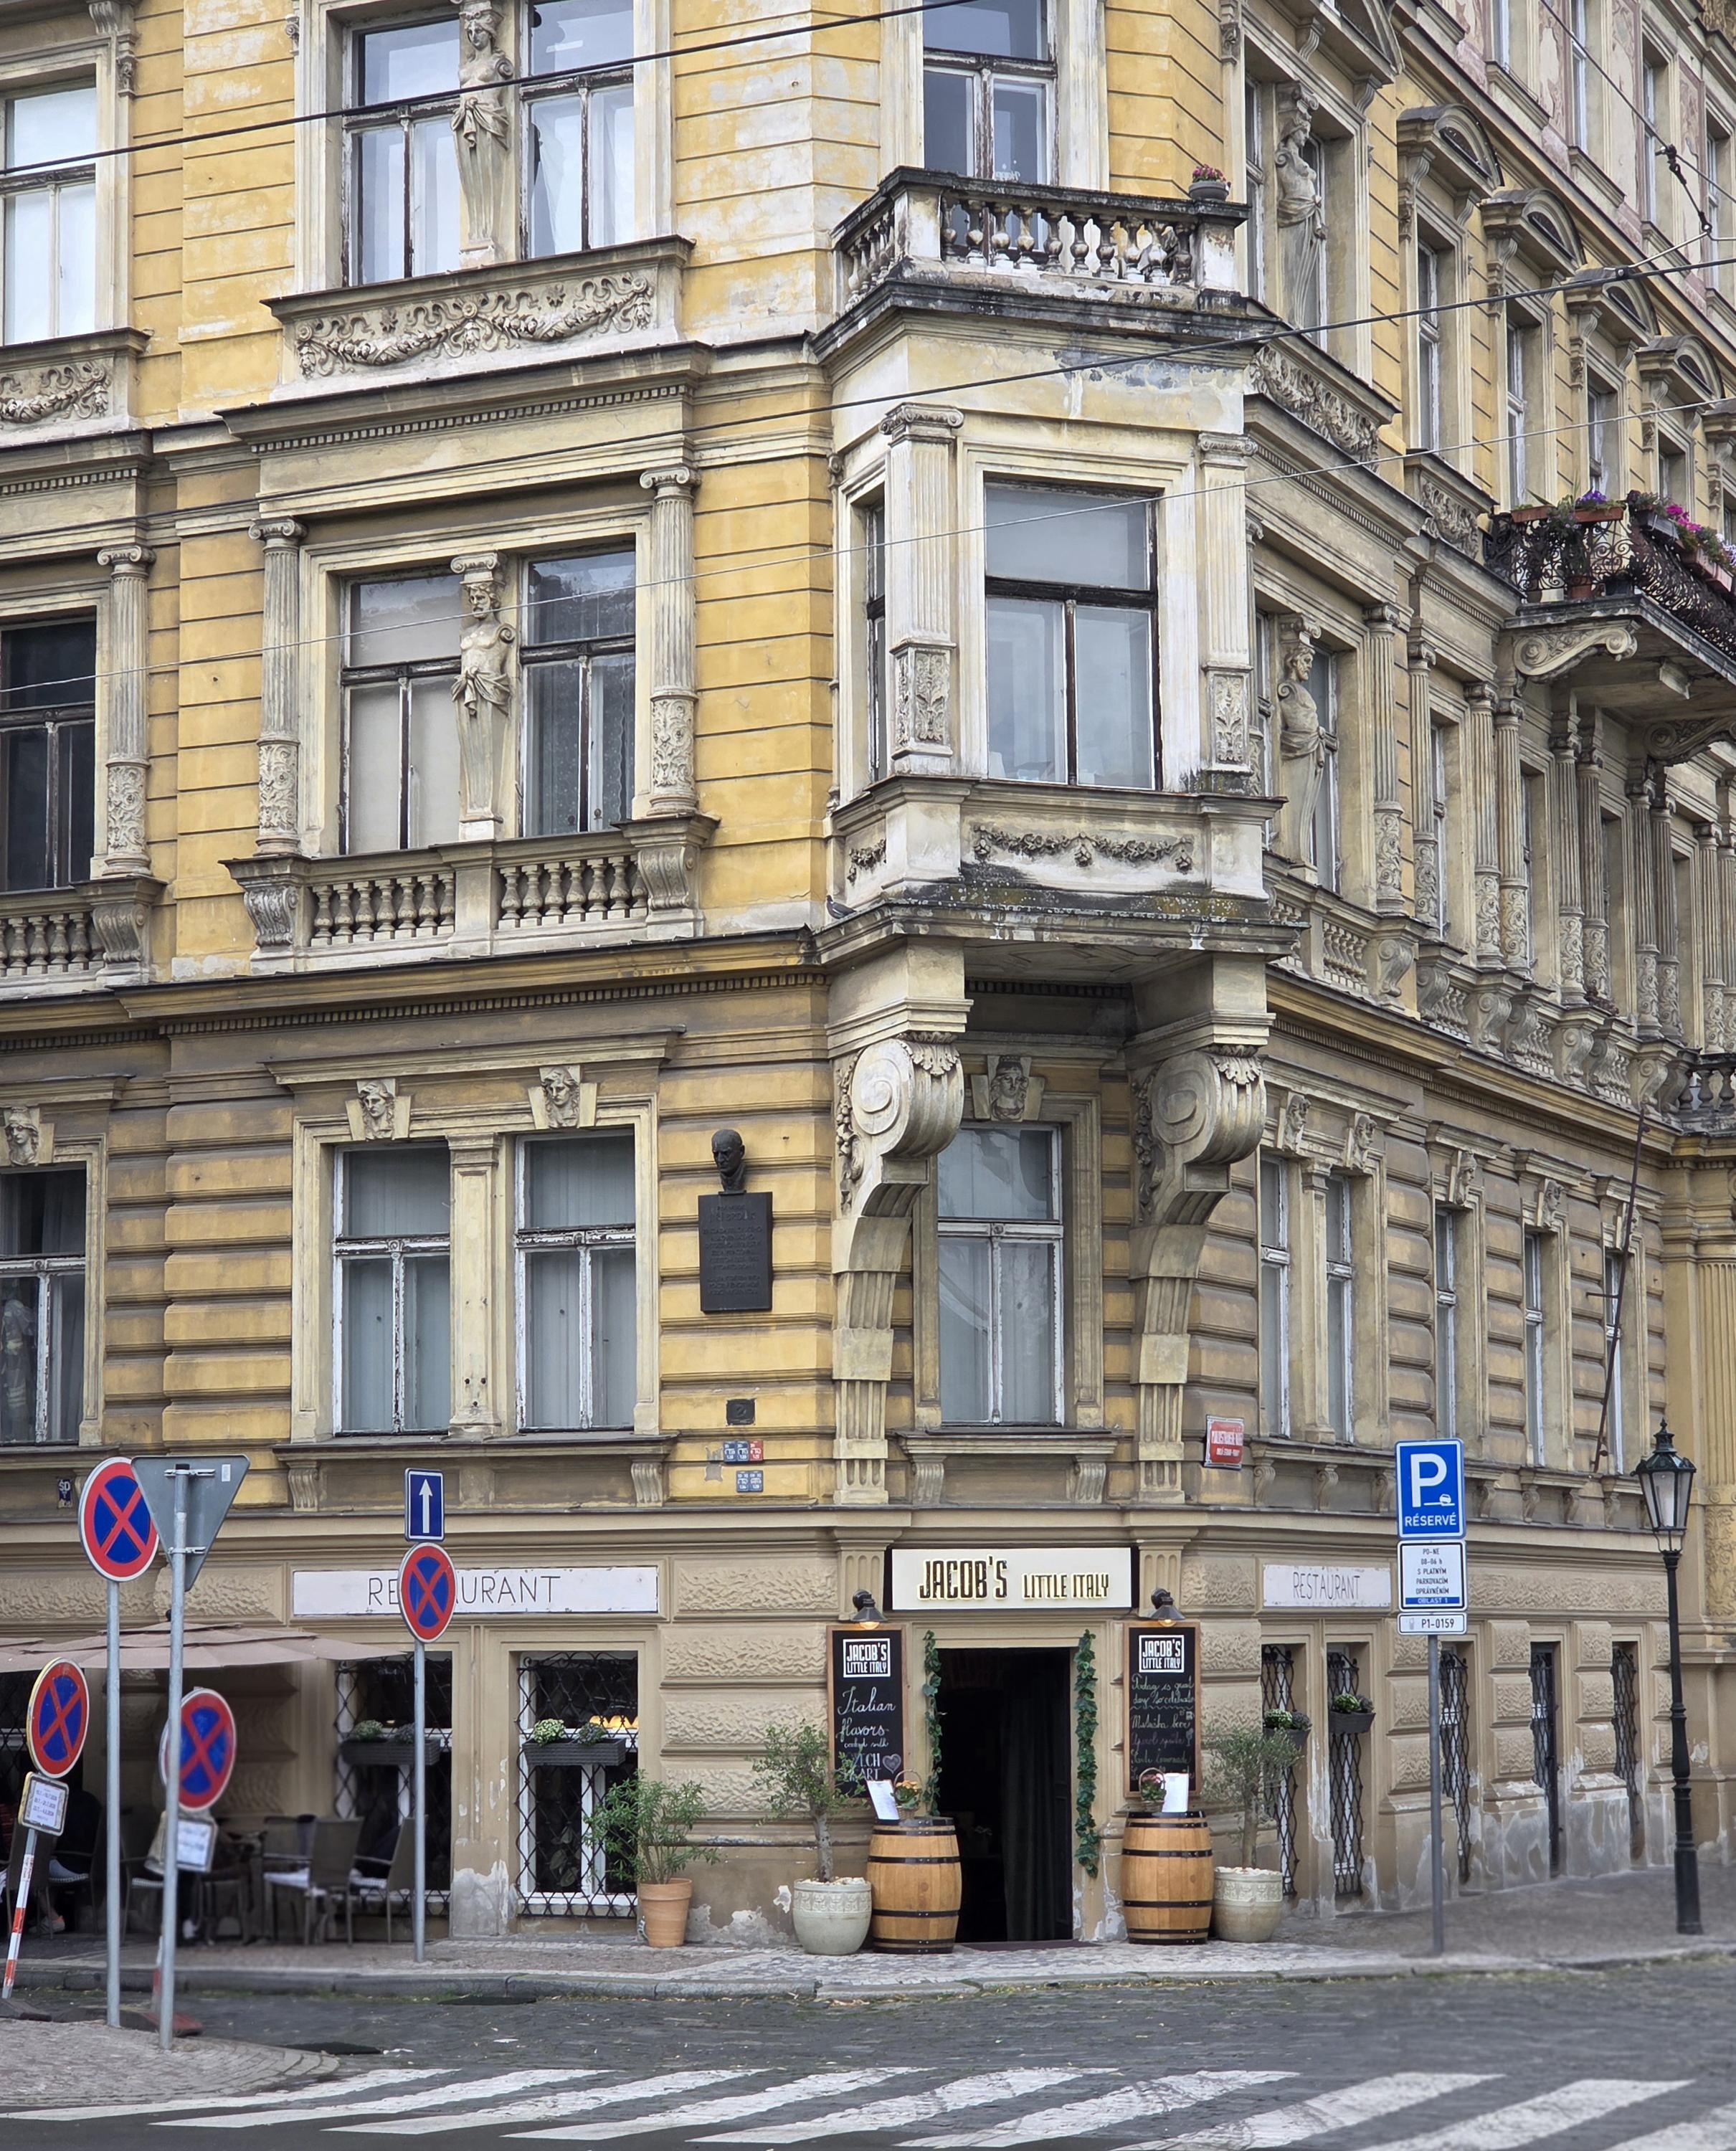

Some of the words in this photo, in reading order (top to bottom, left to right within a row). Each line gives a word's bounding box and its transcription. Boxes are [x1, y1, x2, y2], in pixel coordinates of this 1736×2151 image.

[1410, 1453, 1447, 1507] P
[1405, 1512, 1456, 1526] RÉSERVÉ
[919, 1556, 1007, 1599] JACOB'S
[1023, 1574, 1067, 1598] LITTLE
[1073, 1574, 1109, 1597] ITALY
[1293, 1572, 1360, 1600] RESTAURANT
[369, 1575, 561, 1606] REURANT
[1421, 1618, 1455, 1628] P1-0159
[847, 1643, 887, 1661] JACOB'S
[1142, 1639, 1181, 1657] JACOB'S
[847, 1661, 868, 1673] LITTLE
[869, 1661, 886, 1673] ITALY
[1142, 1658, 1162, 1668] LITTLE
[1164, 1658, 1180, 1668] ITALY
[838, 1686, 896, 1715] Italian
[835, 1717, 889, 1742] flavors
